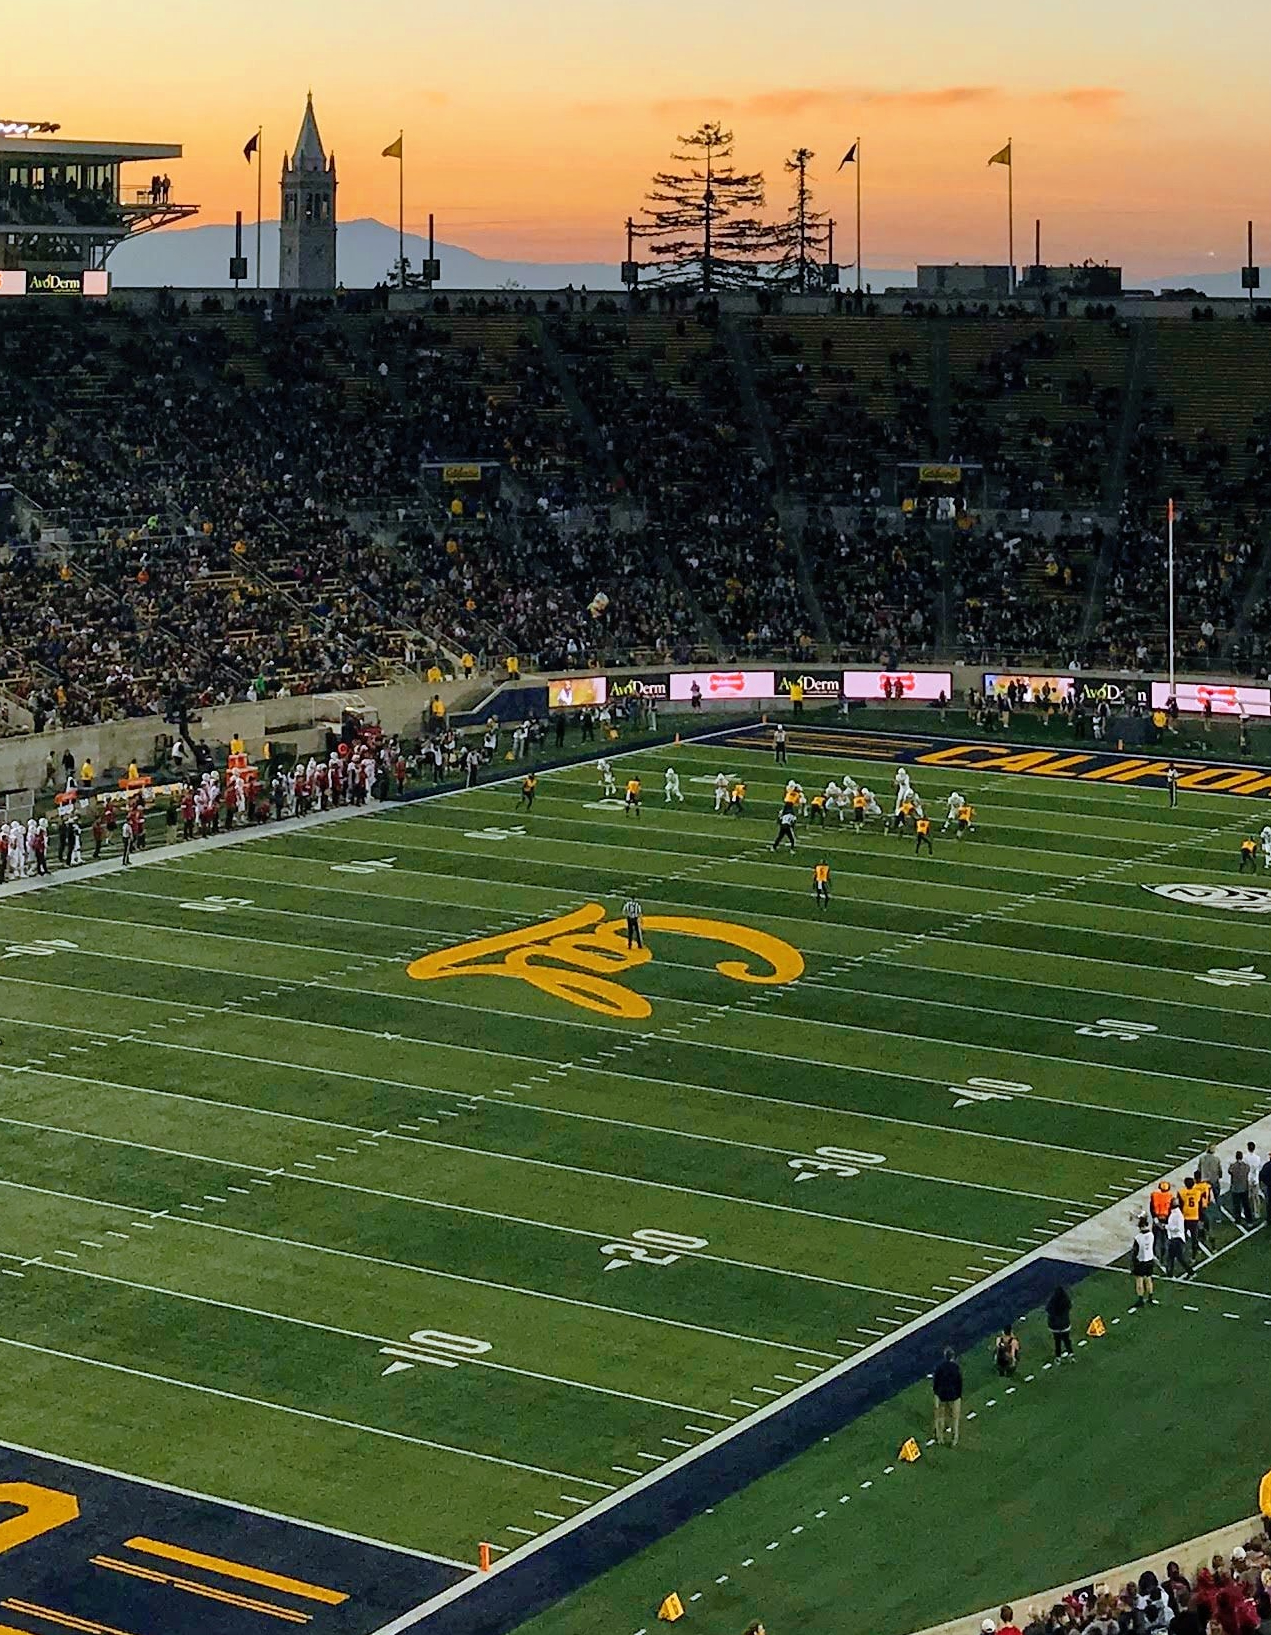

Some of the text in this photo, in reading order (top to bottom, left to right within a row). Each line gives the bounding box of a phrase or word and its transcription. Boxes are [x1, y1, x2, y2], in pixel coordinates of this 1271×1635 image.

[1074, 1019, 1159, 1040] 50
[948, 1077, 1034, 1100] 40
[788, 1146, 887, 1177] 30
[600, 1229, 709, 1266] 20
[379, 1330, 493, 1368] 10
